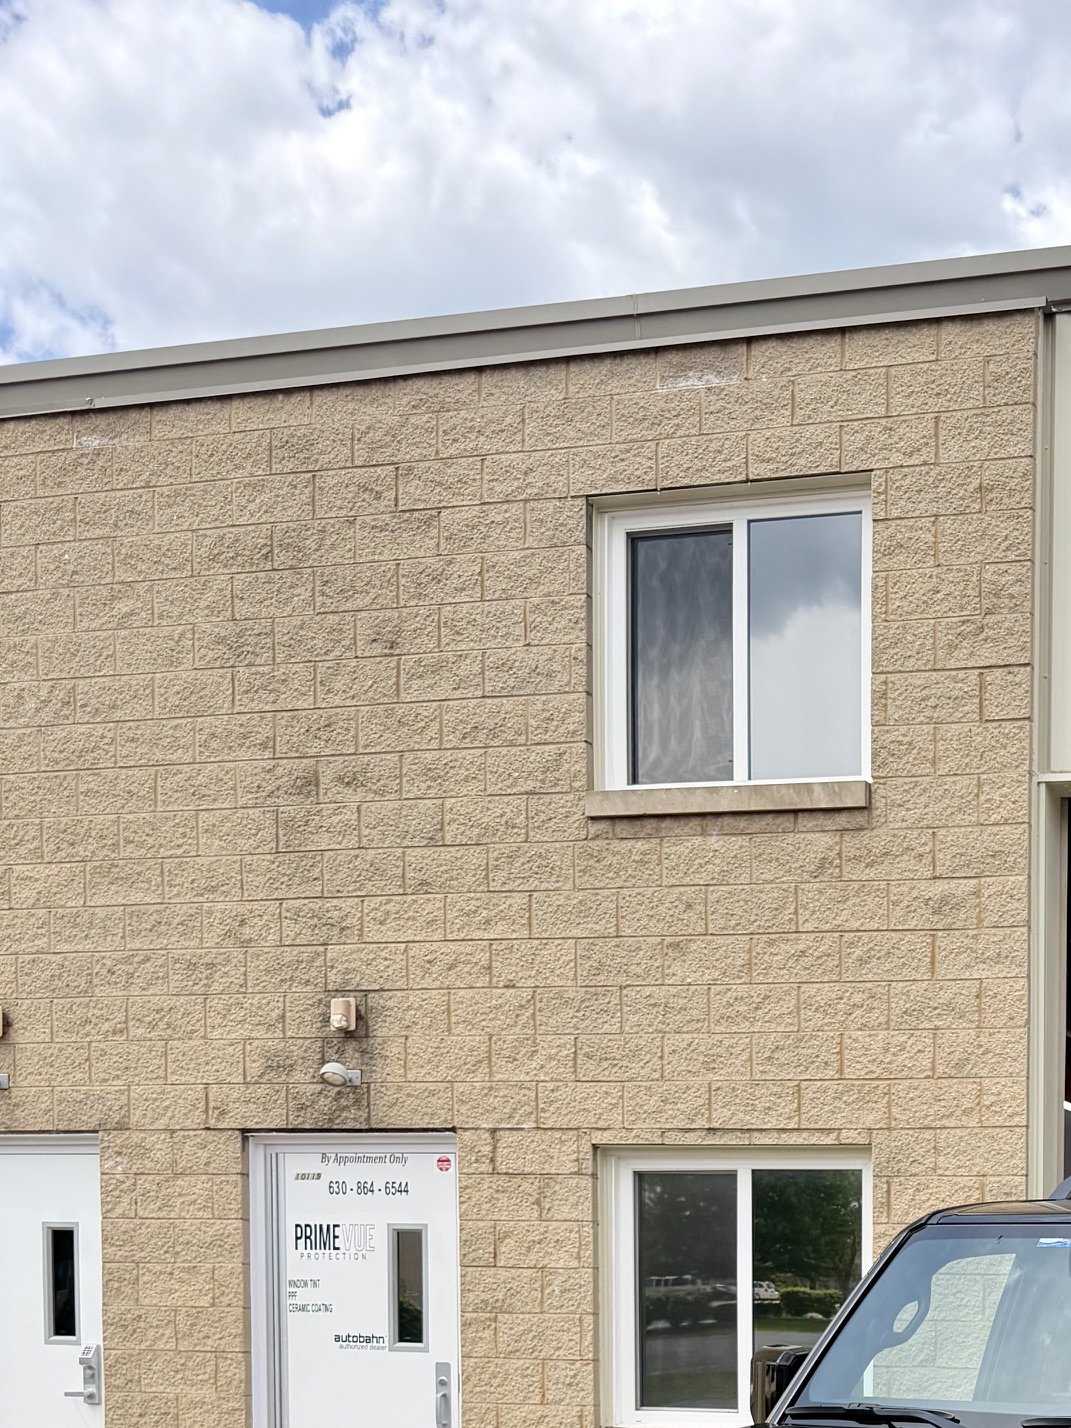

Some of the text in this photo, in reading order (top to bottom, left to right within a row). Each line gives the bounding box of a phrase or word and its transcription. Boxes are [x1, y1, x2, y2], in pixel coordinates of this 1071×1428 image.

[320, 1153, 409, 1166] By Appointment Only
[328, 1180, 347, 1195] 630
[356, 1180, 375, 1196] 864
[384, 1181, 410, 1196] 6544
[300, 1252, 368, 1261] PROTECTION
[288, 1279, 320, 1288] WINDOW TINT
[288, 1303, 333, 1313] CERAMIC COATING
[334, 1333, 385, 1344] autobahn
[339, 1343, 369, 1351] authorized
